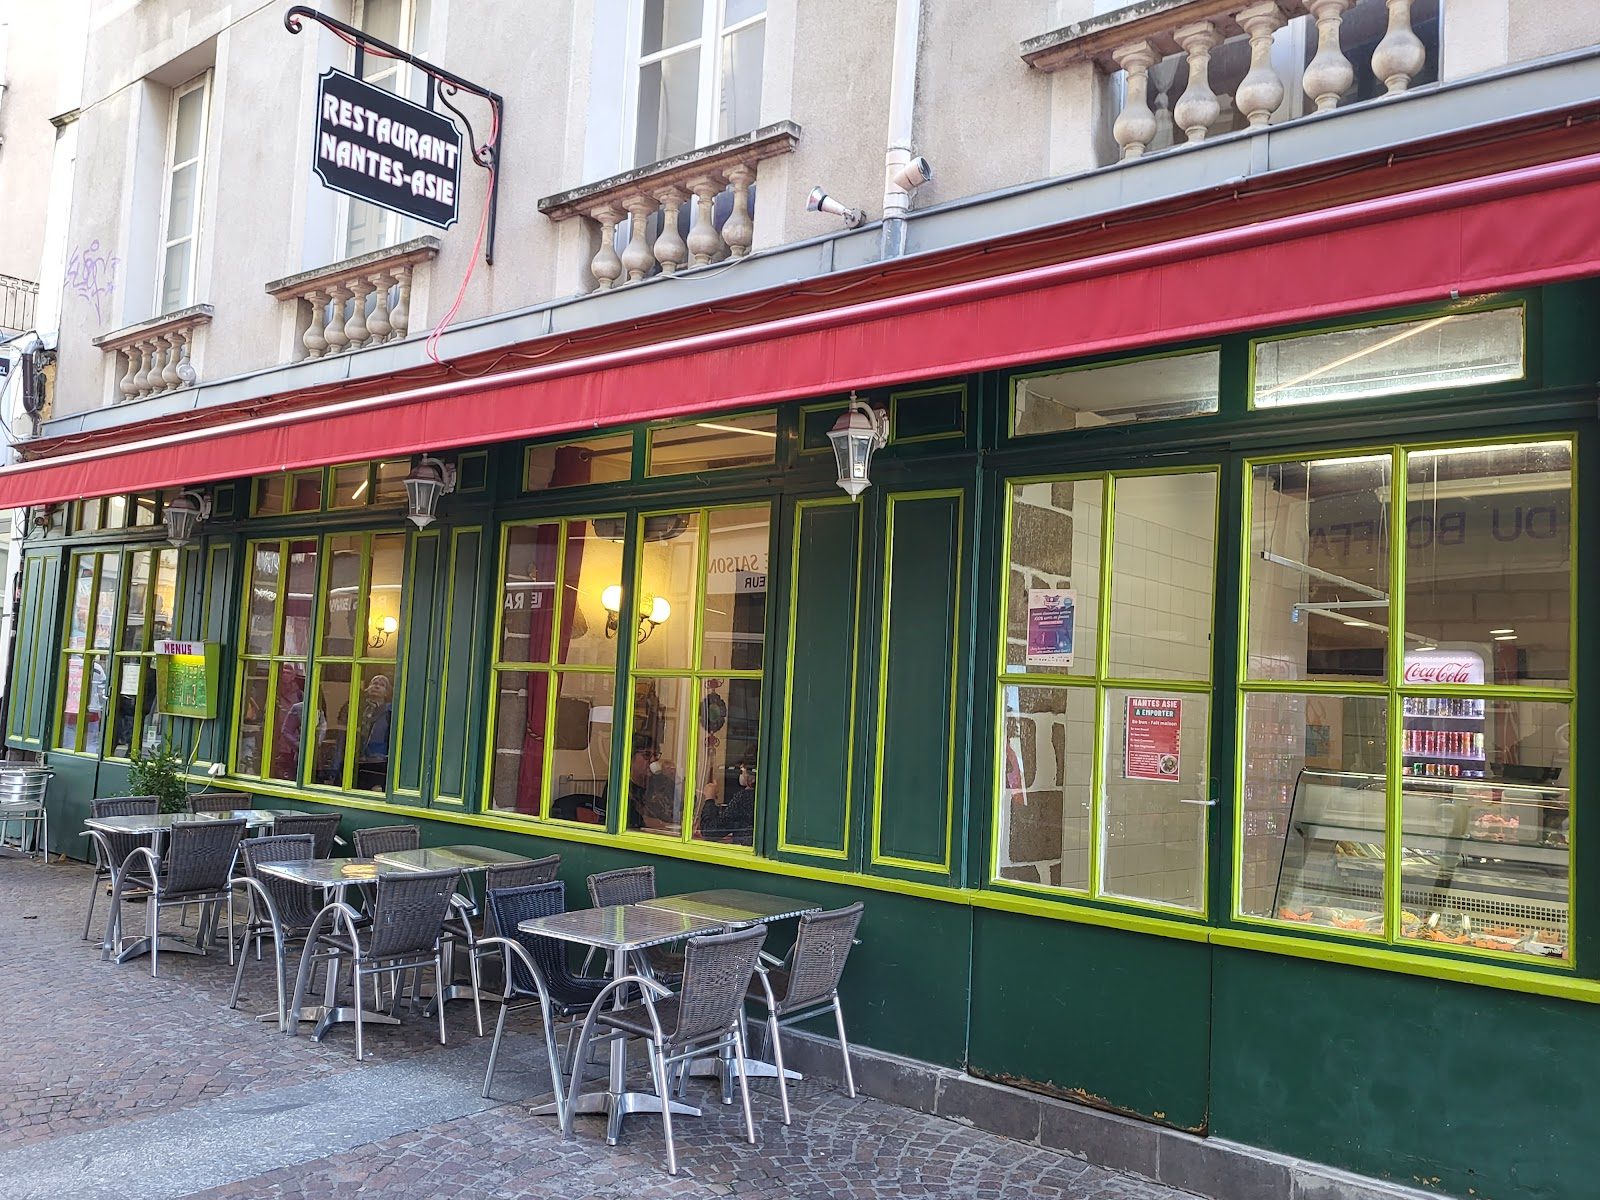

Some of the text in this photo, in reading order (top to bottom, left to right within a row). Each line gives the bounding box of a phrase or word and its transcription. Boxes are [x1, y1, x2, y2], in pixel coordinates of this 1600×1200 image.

[323, 92, 458, 169] RESTAURANT
[320, 131, 454, 206] NANTES-ASIE
[164, 643, 192, 655] MENUS
[1132, 699, 1177, 708] NANTES ASIE
[1142, 709, 1173, 717] EMPORTER
